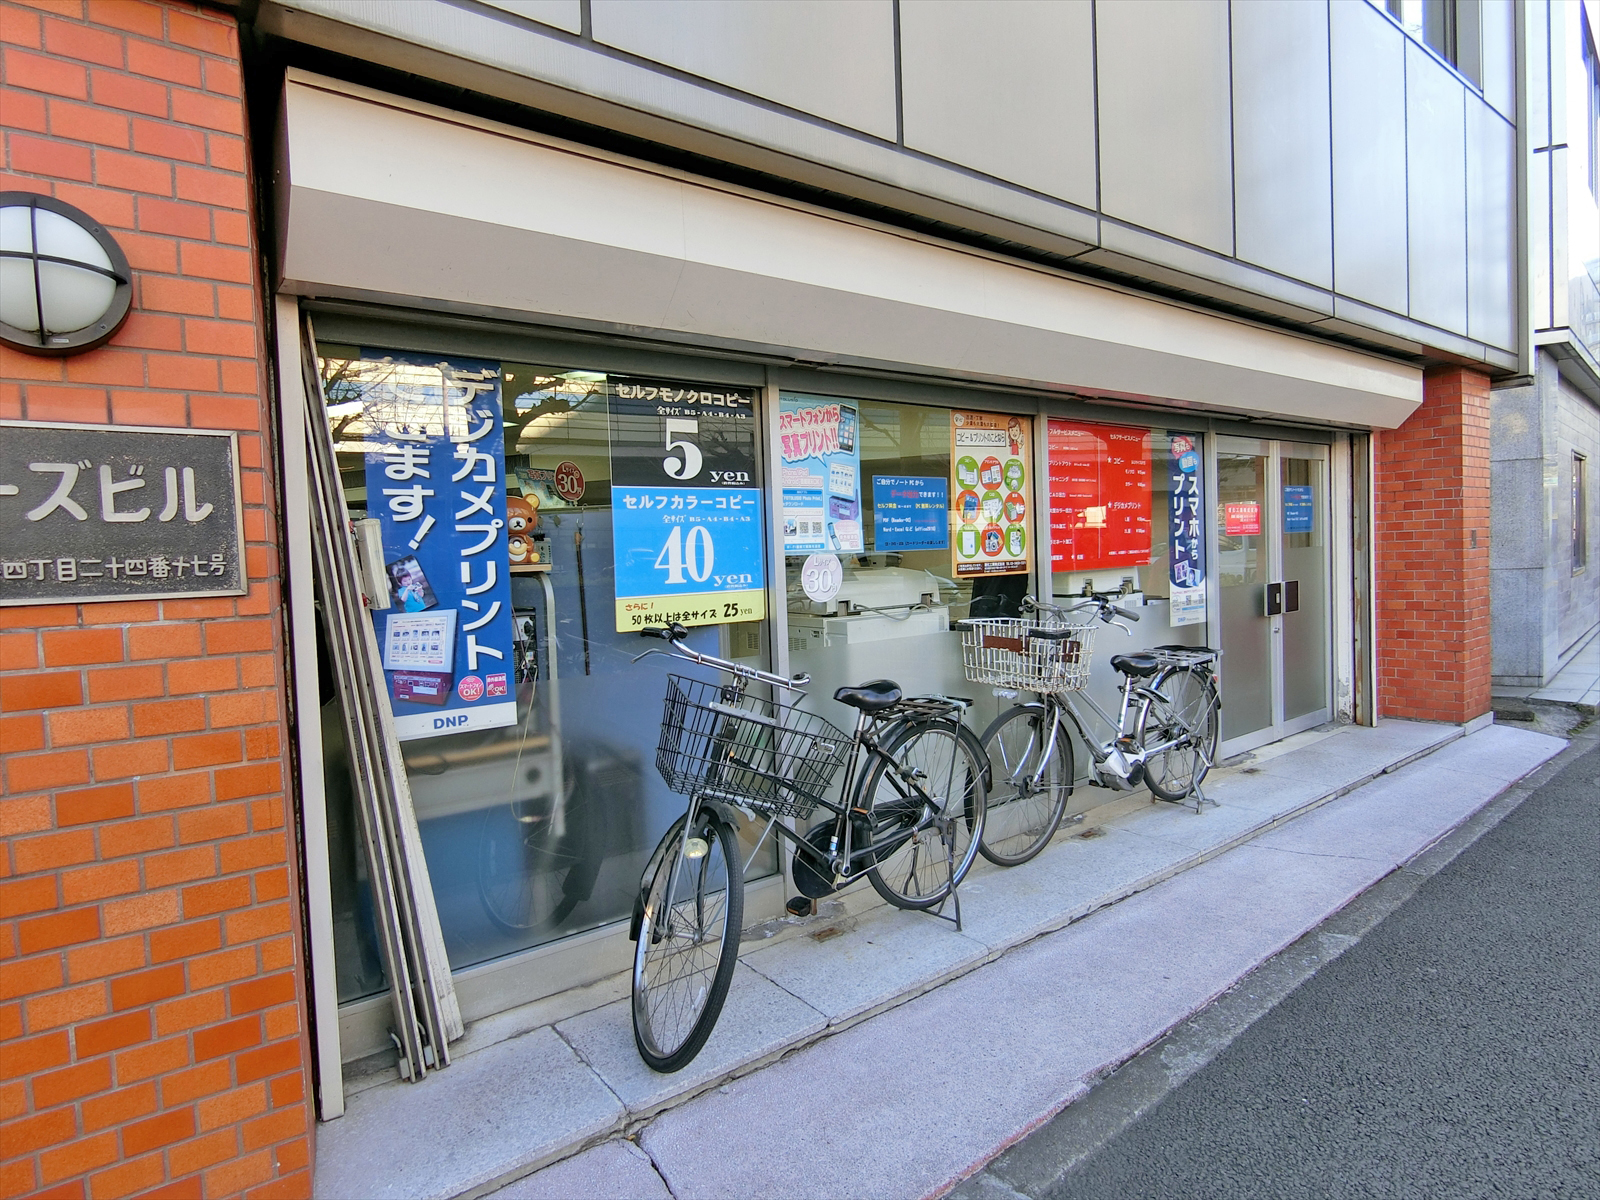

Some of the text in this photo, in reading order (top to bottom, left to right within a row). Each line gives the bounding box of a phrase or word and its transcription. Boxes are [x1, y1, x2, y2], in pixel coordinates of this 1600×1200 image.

[615, 383, 750, 408] セルフモノクロコピー
[779, 407, 840, 431] スマートフォンから
[663, 418, 750, 482] 5 yen
[781, 427, 839, 459] 写真プリント!!
[623, 494, 755, 510] セルフカラーコピー
[449, 369, 504, 670] デジカメプリント
[1173, 473, 1186, 560] プリント
[654, 526, 753, 587] 40 yen
[723, 603, 739, 618] 25
[740, 608, 753, 616] yen
[463, 687, 480, 696] OK!
[433, 714, 469, 730] DNP
